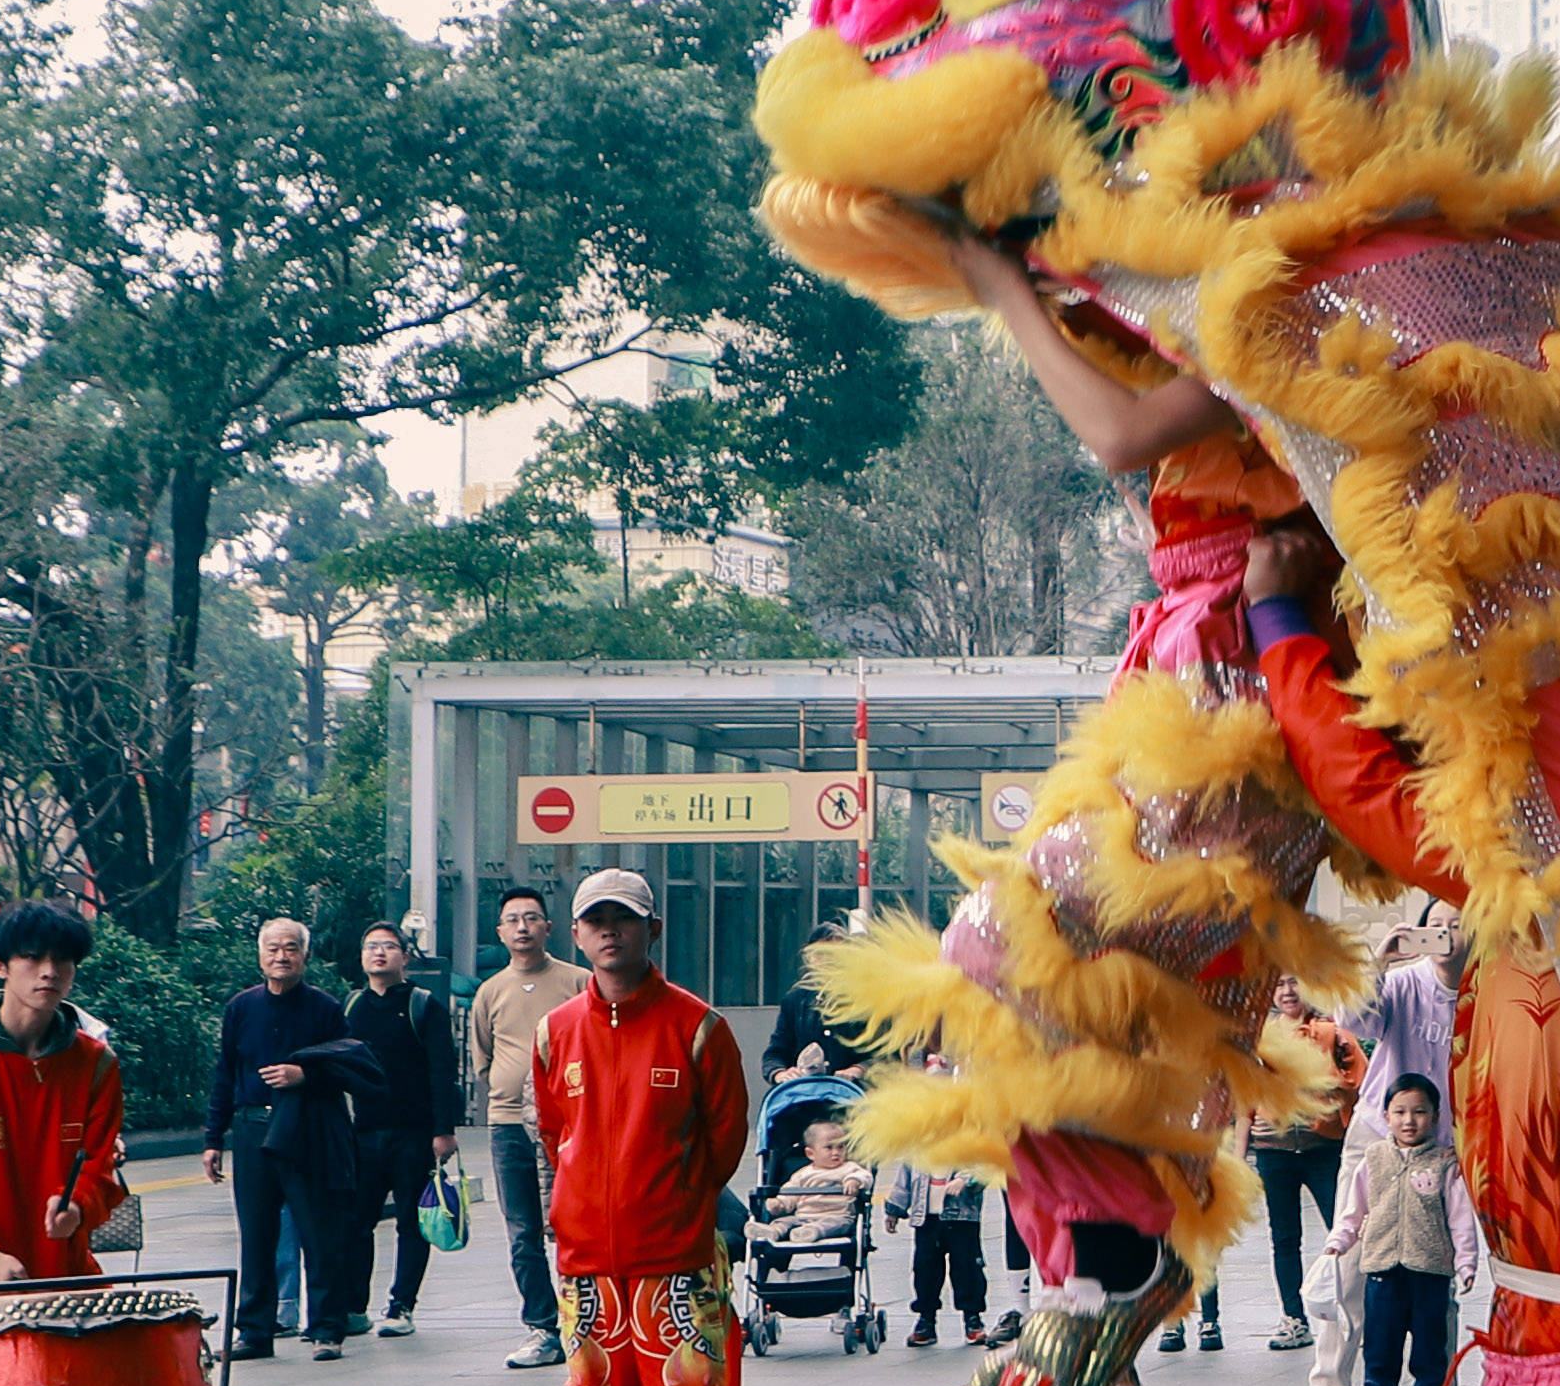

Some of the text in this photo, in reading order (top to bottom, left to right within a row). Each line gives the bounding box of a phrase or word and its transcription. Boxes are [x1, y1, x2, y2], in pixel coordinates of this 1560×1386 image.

[642, 793, 670, 807] 地下
[688, 793, 752, 823] 出口
[634, 809, 677, 822] 停车场
